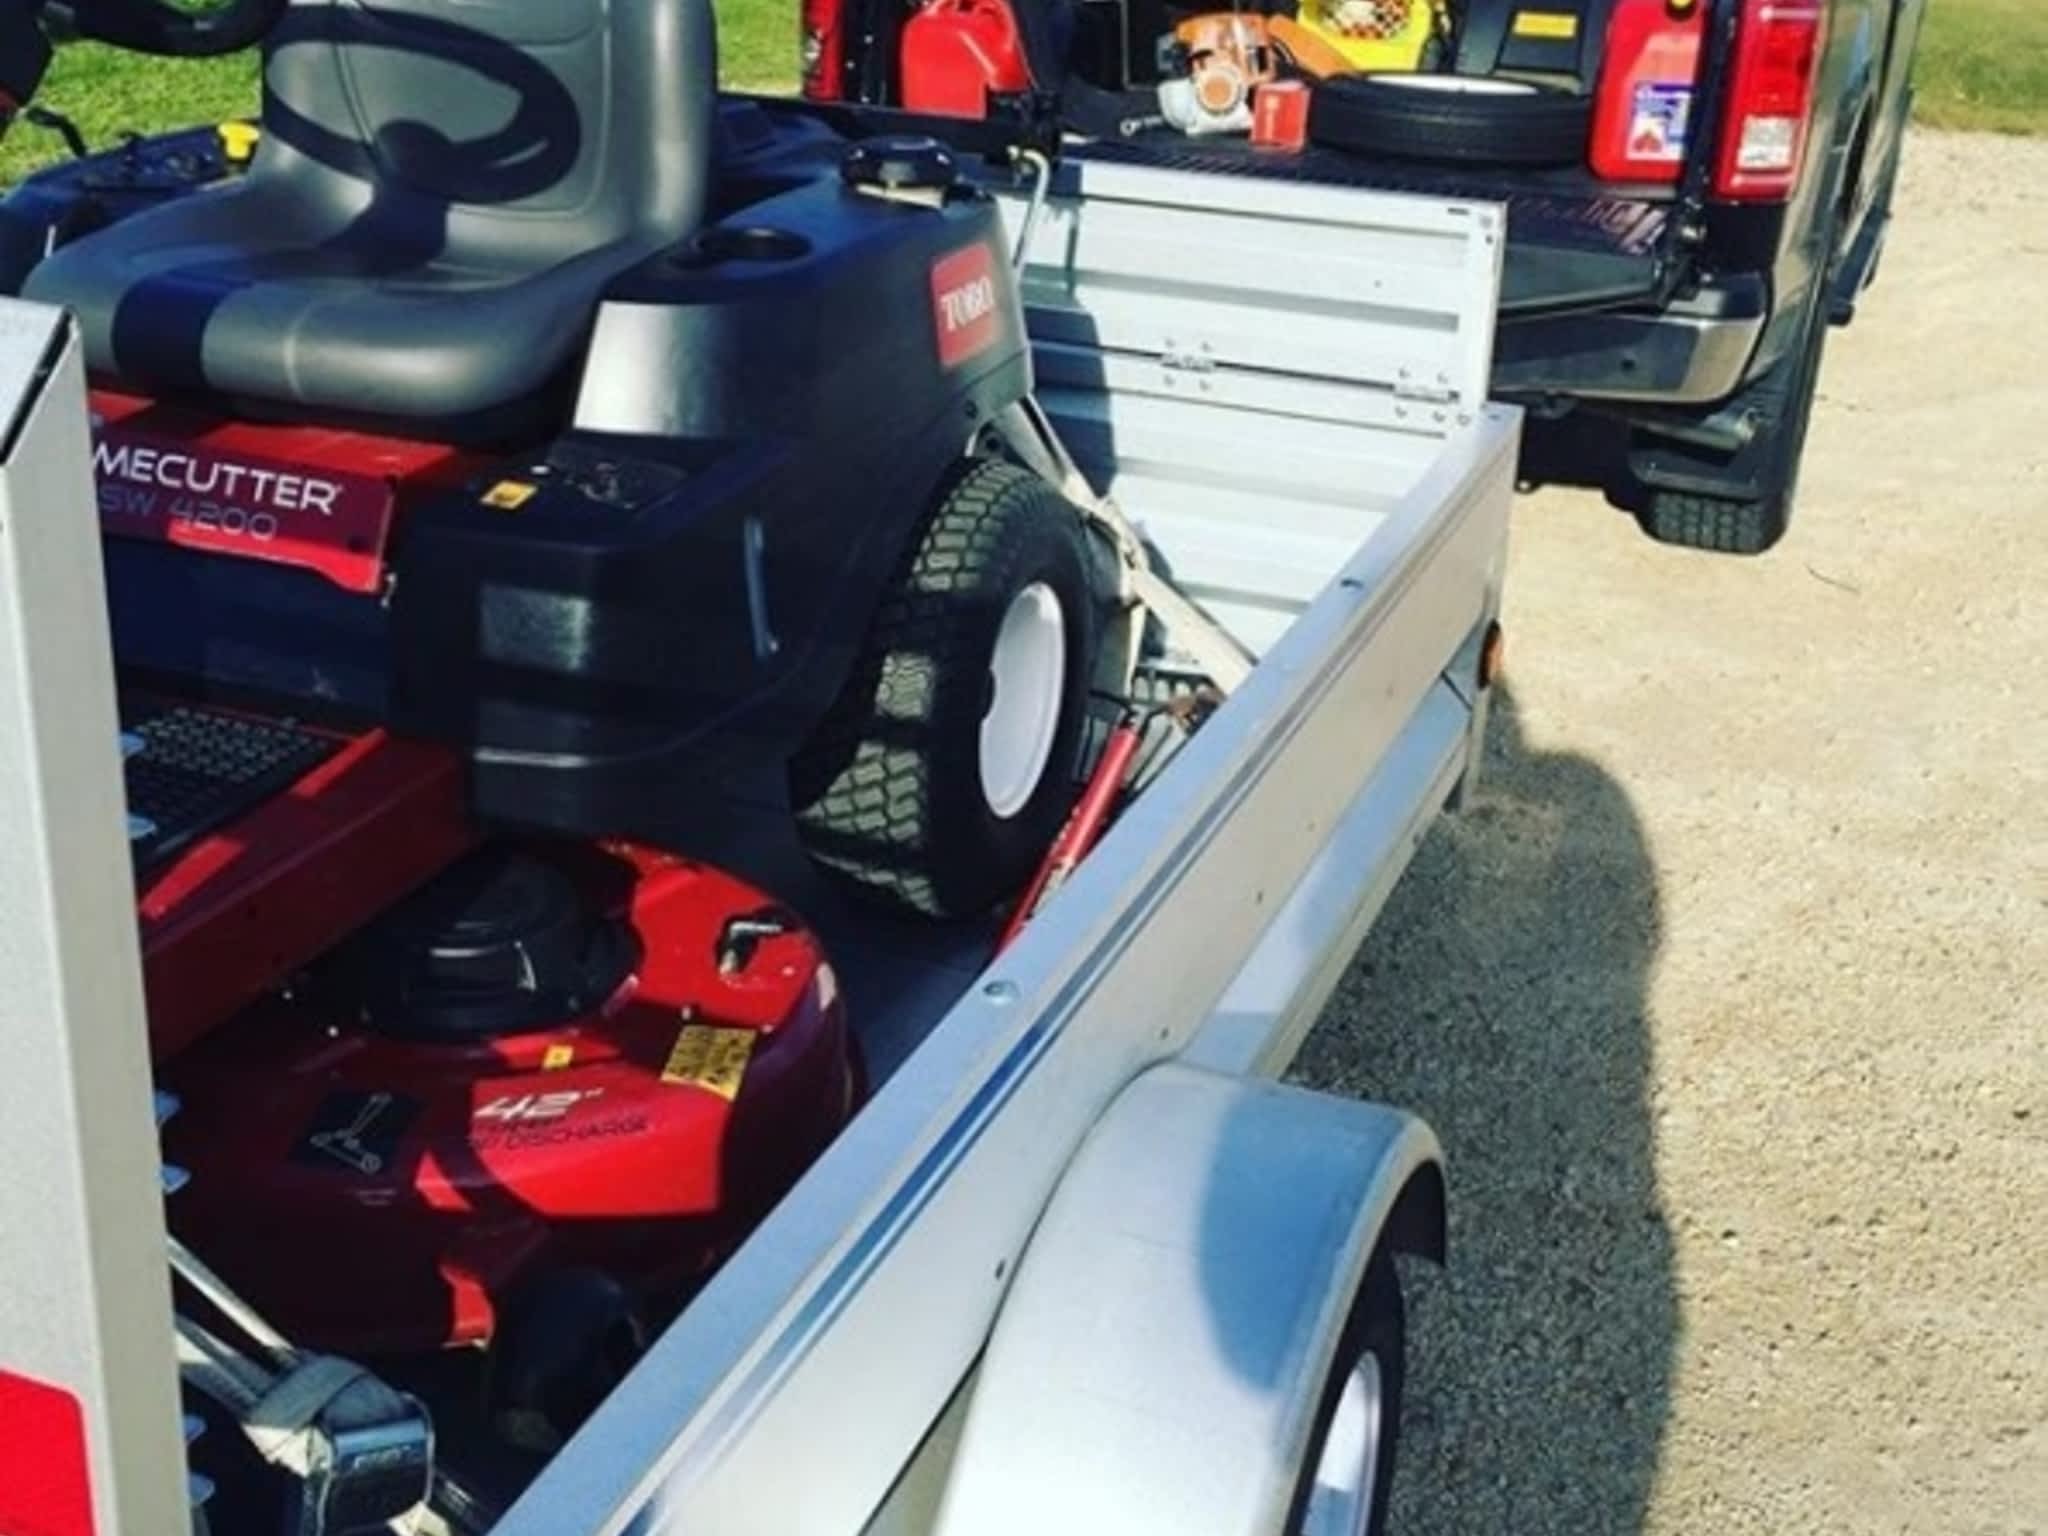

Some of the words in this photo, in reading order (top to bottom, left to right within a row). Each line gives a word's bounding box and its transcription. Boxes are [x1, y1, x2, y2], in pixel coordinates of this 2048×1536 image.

[940, 276, 995, 331] TORO
[93, 442, 339, 514] MECUTTER
[170, 497, 277, 541] 4200
